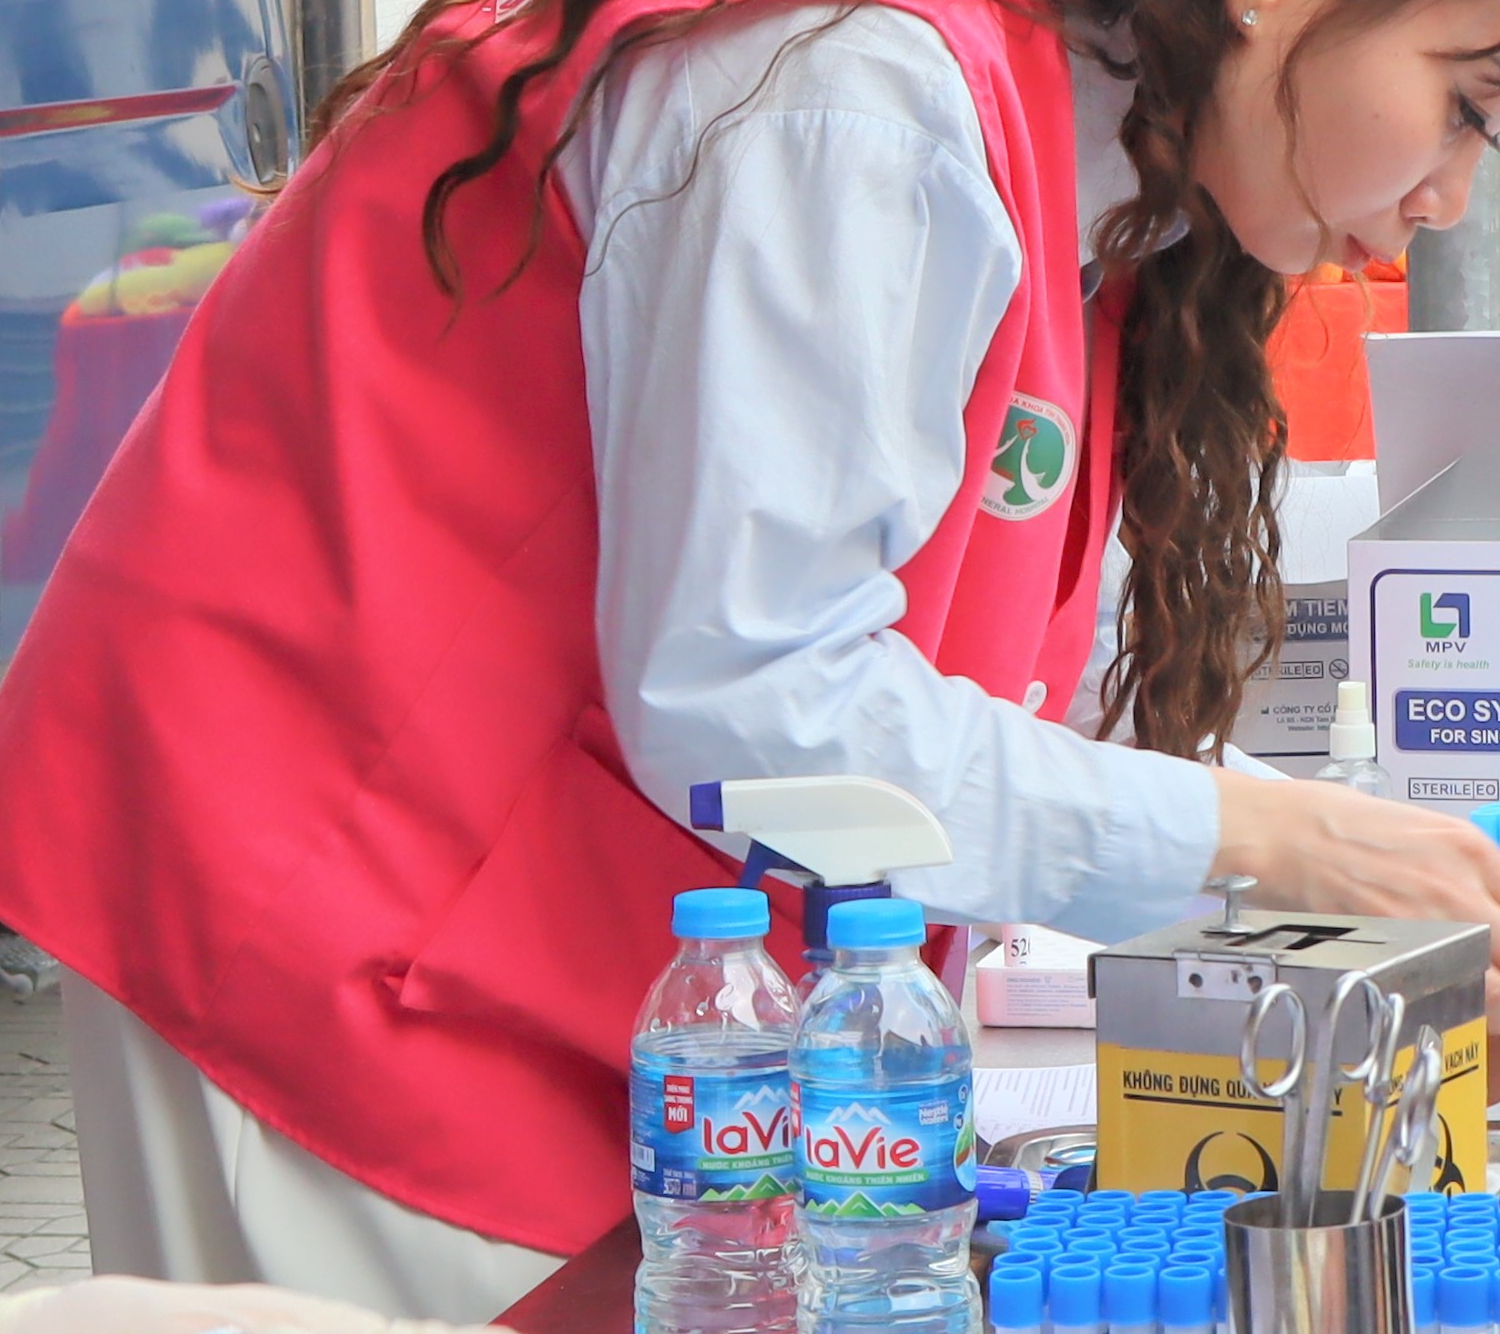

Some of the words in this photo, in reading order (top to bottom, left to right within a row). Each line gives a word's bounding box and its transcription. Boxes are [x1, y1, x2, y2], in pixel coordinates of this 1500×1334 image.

[981, 496, 1012, 516] NERAL
[1425, 641, 1467, 654] MPV
[1305, 665, 1321, 675] EO
[1407, 658, 1441, 671] Safety
[1443, 658, 1453, 669] is
[1456, 658, 1490, 670] health
[1303, 705, 1315, 714] TY
[1408, 698, 1466, 722] ECO
[1430, 728, 1467, 745] FOR
[1412, 782, 1472, 796] STERILE
[1476, 782, 1496, 796] EO
[1011, 937, 1031, 957] 52
[1123, 1066, 1173, 1093] KHÔNG
[1179, 1075, 1221, 1098] ĐỰNG
[701, 1106, 791, 1155] laVi
[804, 1124, 921, 1170] laVie
